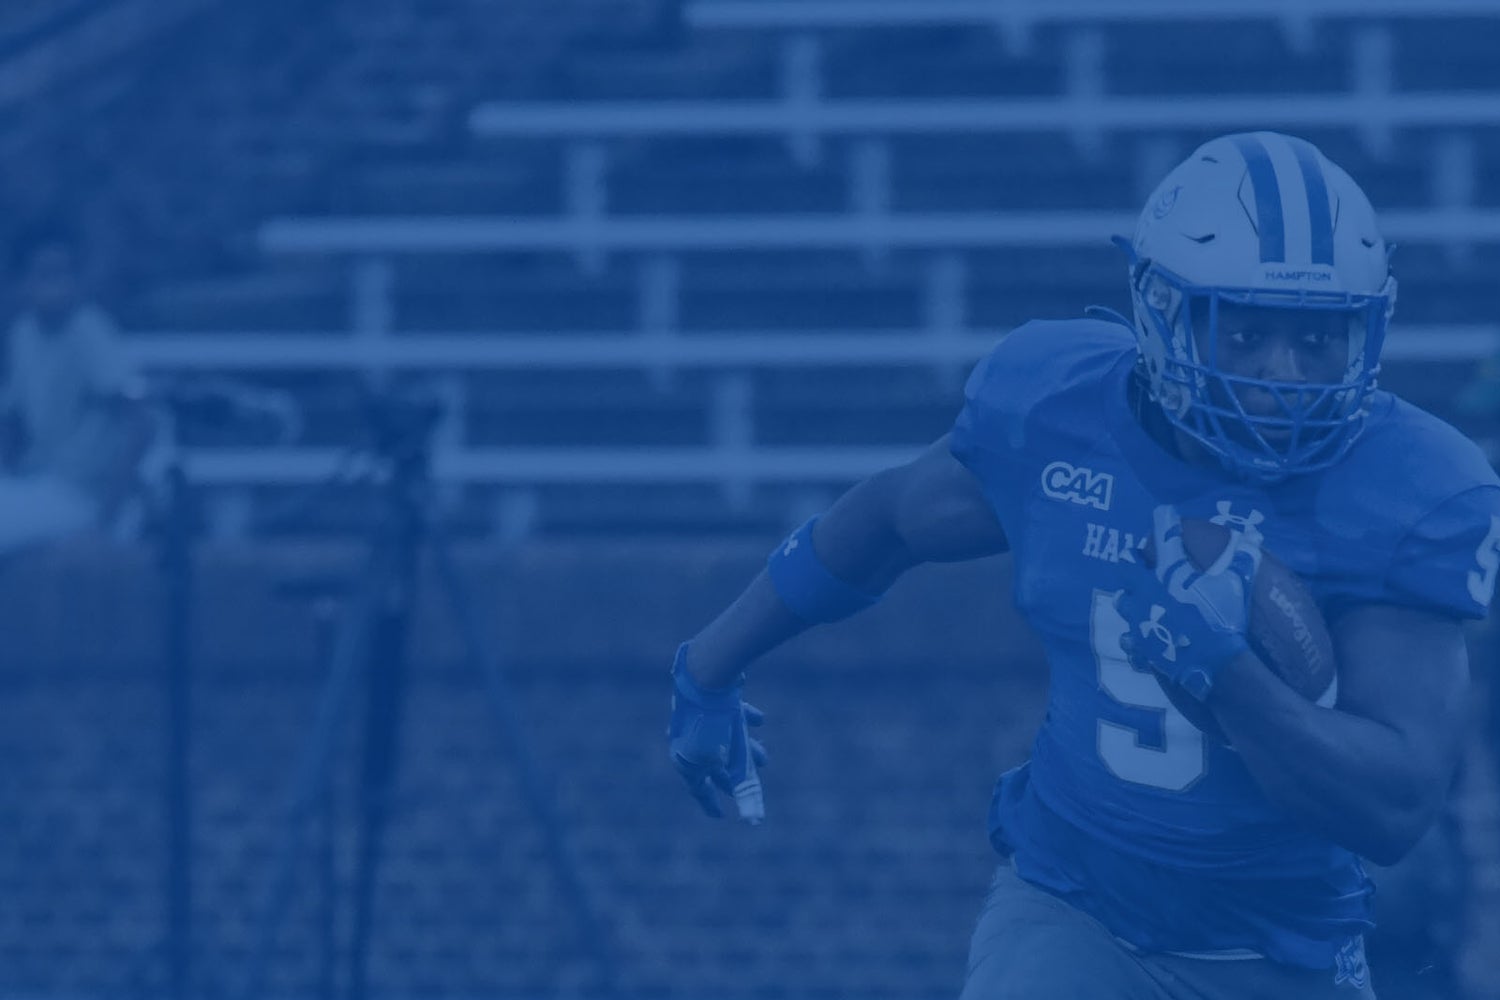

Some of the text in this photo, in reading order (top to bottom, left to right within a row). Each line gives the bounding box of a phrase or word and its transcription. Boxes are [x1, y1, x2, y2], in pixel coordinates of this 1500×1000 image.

[1265, 271, 1331, 281] HAMPTON
[1041, 461, 1114, 511] CAA
[1091, 588, 1209, 792] 5
